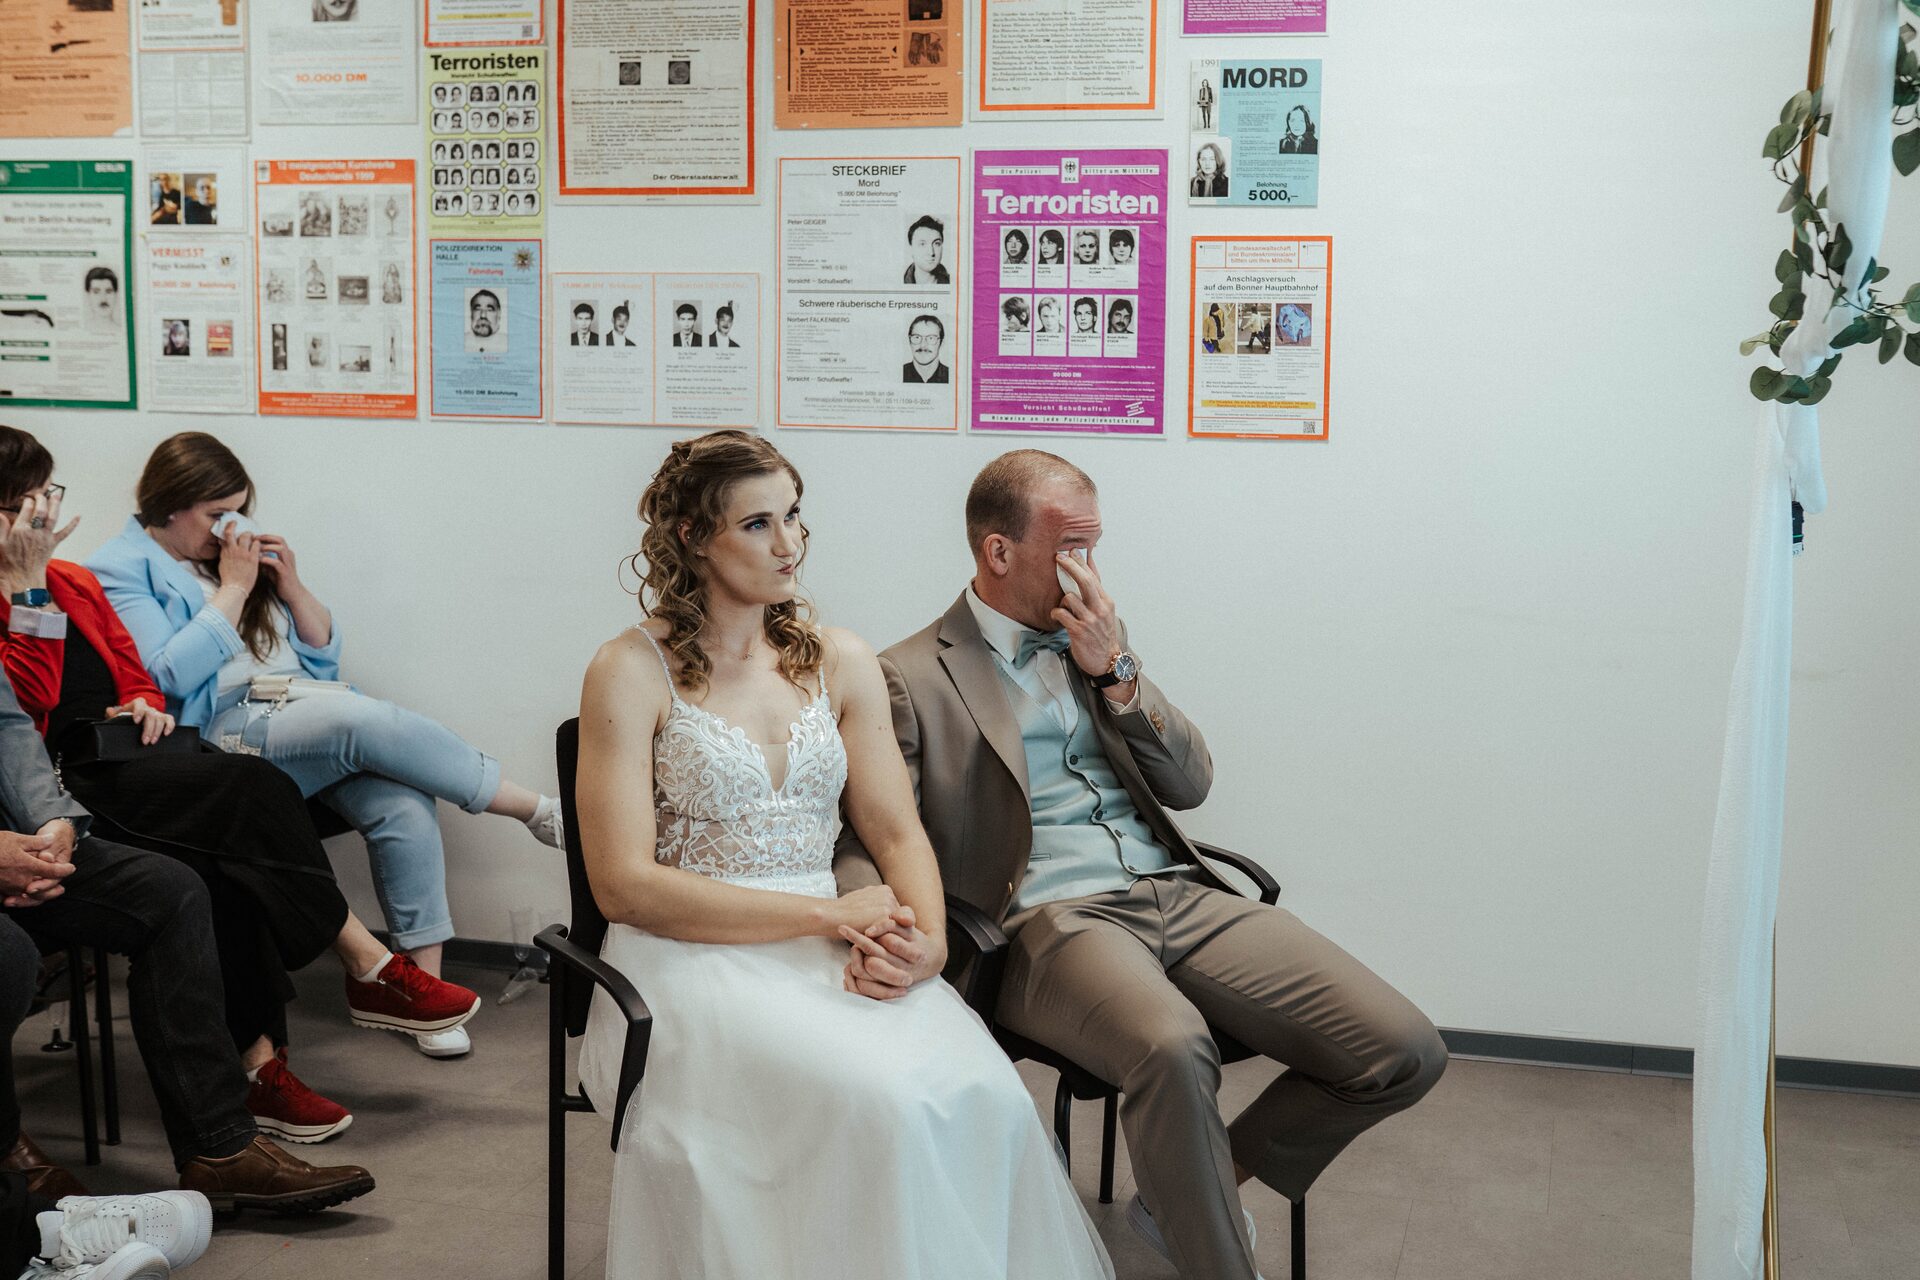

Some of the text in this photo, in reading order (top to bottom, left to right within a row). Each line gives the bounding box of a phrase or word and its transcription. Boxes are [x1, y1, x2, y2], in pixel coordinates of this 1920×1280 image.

[430, 53, 539, 70] Terroristen
[296, 73, 368, 82] 10.000 DM
[1222, 67, 1308, 88] MORD
[832, 166, 907, 176] STECKBRIEF
[858, 179, 880, 188] Mord
[1256, 182, 1288, 190] Belohnung
[982, 189, 1158, 214] Terroristen
[468, 268, 504, 276] Fahndung
[1226, 275, 1296, 284] Anschlagsversuch
[1265, 284, 1318, 292] Hauptbahnhof
[799, 300, 938, 310] Schwere räuberische Erpressung
[1058, 405, 1111, 413] Schußwaffen!
